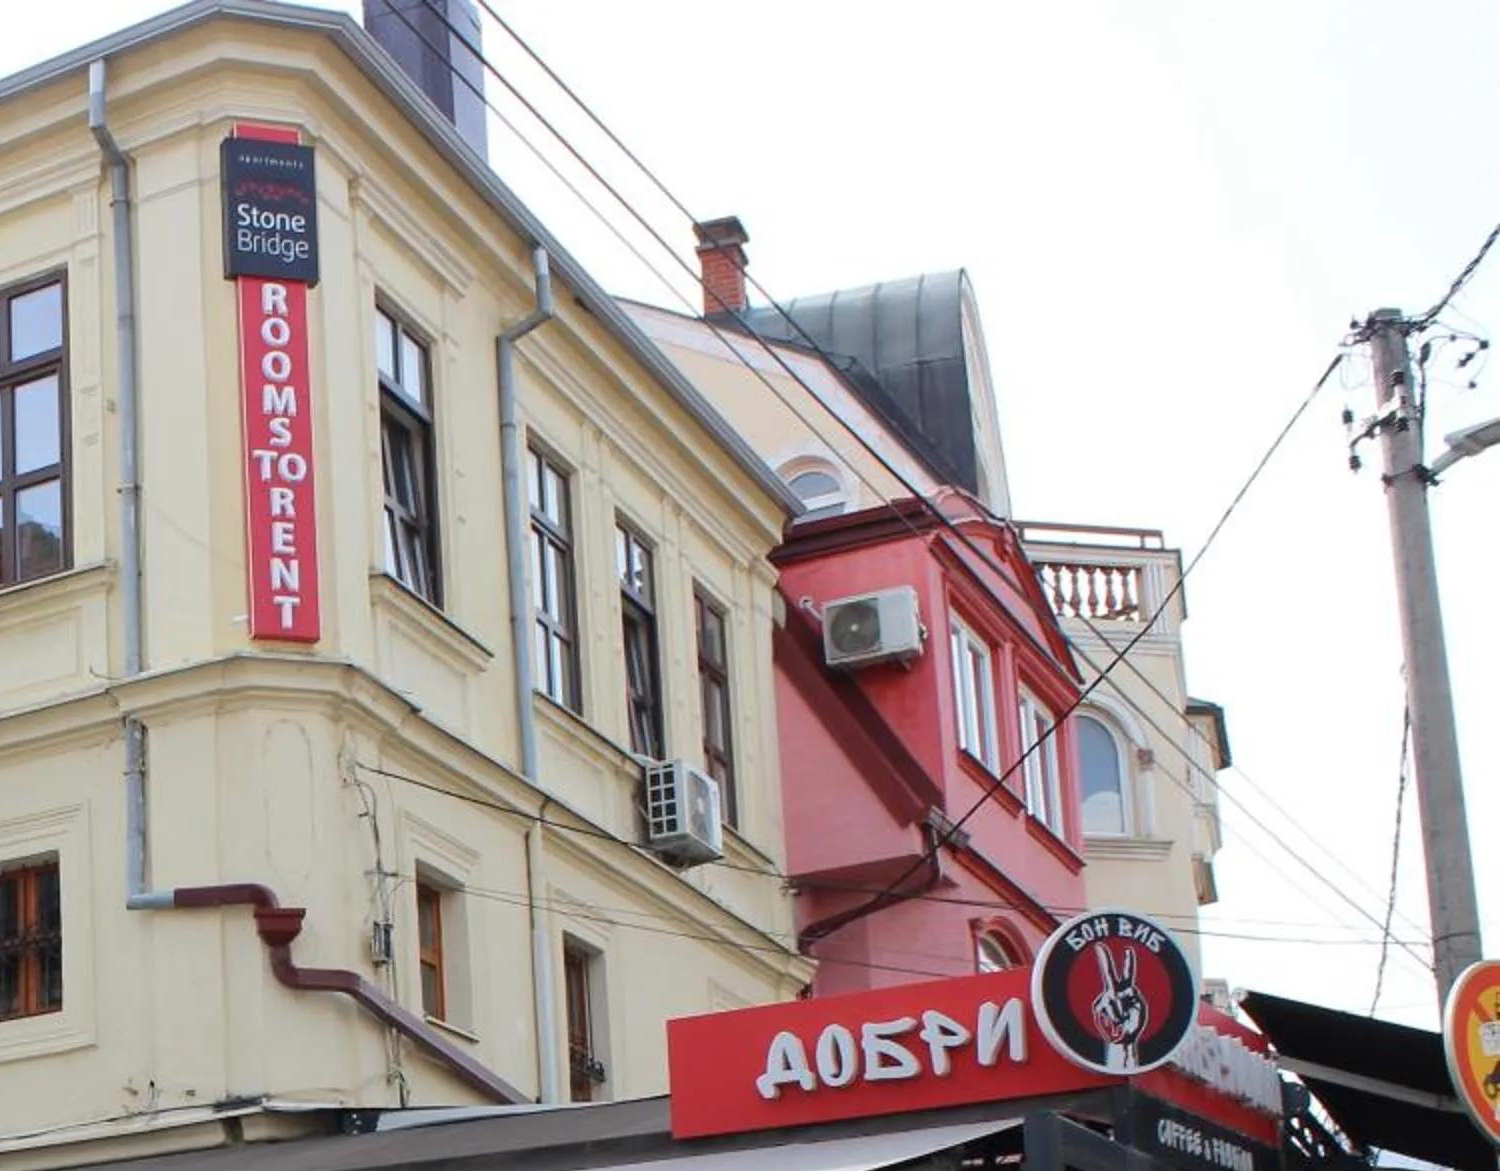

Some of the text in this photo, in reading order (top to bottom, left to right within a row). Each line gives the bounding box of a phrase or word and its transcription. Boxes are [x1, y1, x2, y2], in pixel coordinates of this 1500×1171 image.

[237, 203, 306, 233] Stone
[237, 229, 309, 262] Bridge
[252, 282, 307, 630] ROOMS TO RENT
[1065, 917, 1166, 953] БОН ВИБ
[755, 996, 1028, 1100] ДОБРИ
